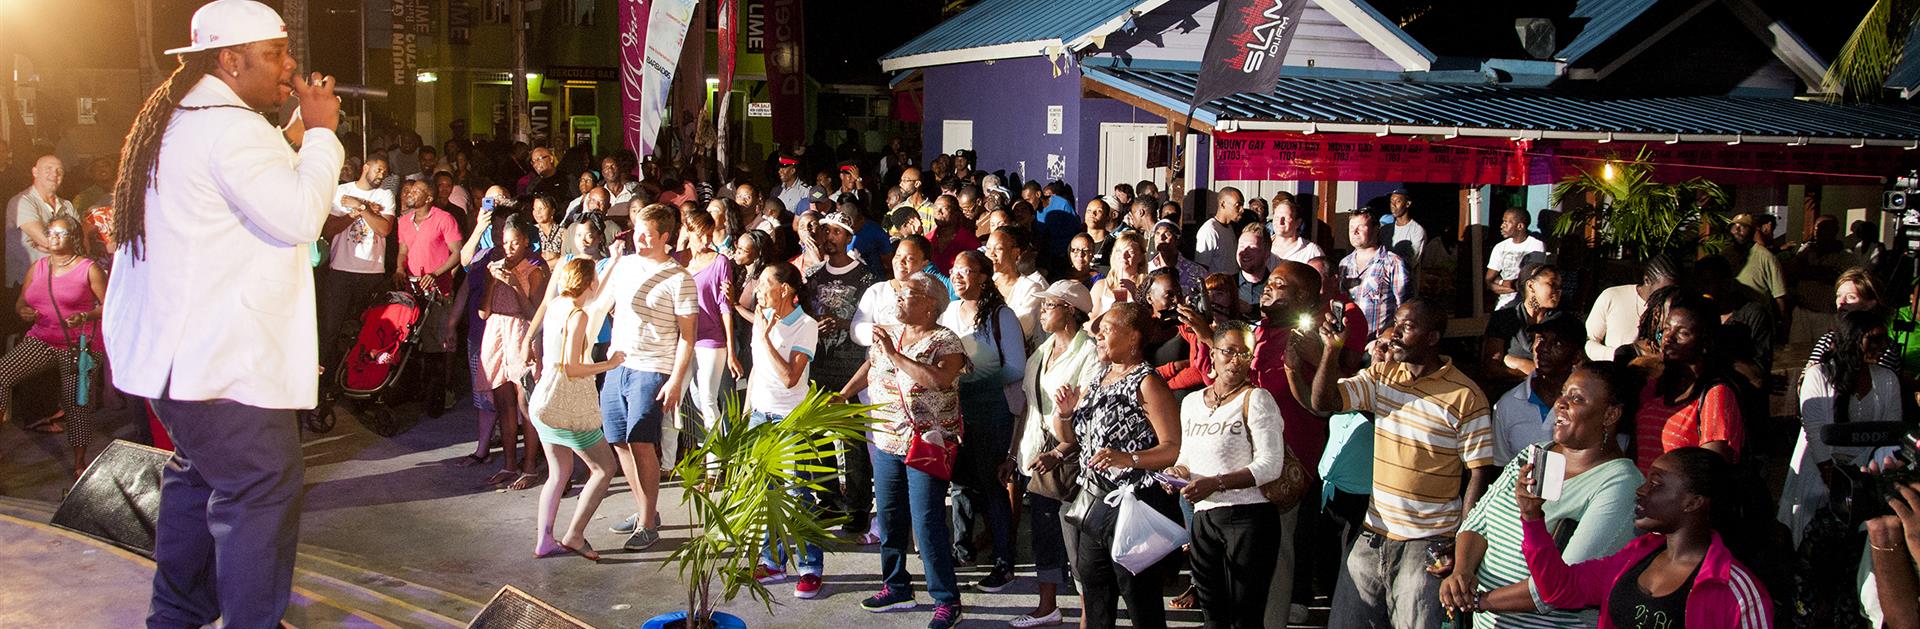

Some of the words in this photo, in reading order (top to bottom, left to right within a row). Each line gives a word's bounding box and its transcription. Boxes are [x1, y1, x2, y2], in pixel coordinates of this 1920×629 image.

[748, 3, 765, 49] LIME
[646, 56, 672, 80] BARBADOS
[598, 68, 616, 80] BAR
[531, 105, 549, 137] LIM
[1216, 139, 1248, 149] MOUNT
[1248, 139, 1266, 150] GAY
[1273, 140, 1303, 151] MOUNT
[1328, 142, 1355, 152] MOUNT
[1224, 150, 1241, 160] 1703
[1280, 151, 1296, 161] 1703
[1185, 418, 1243, 437] Amore
